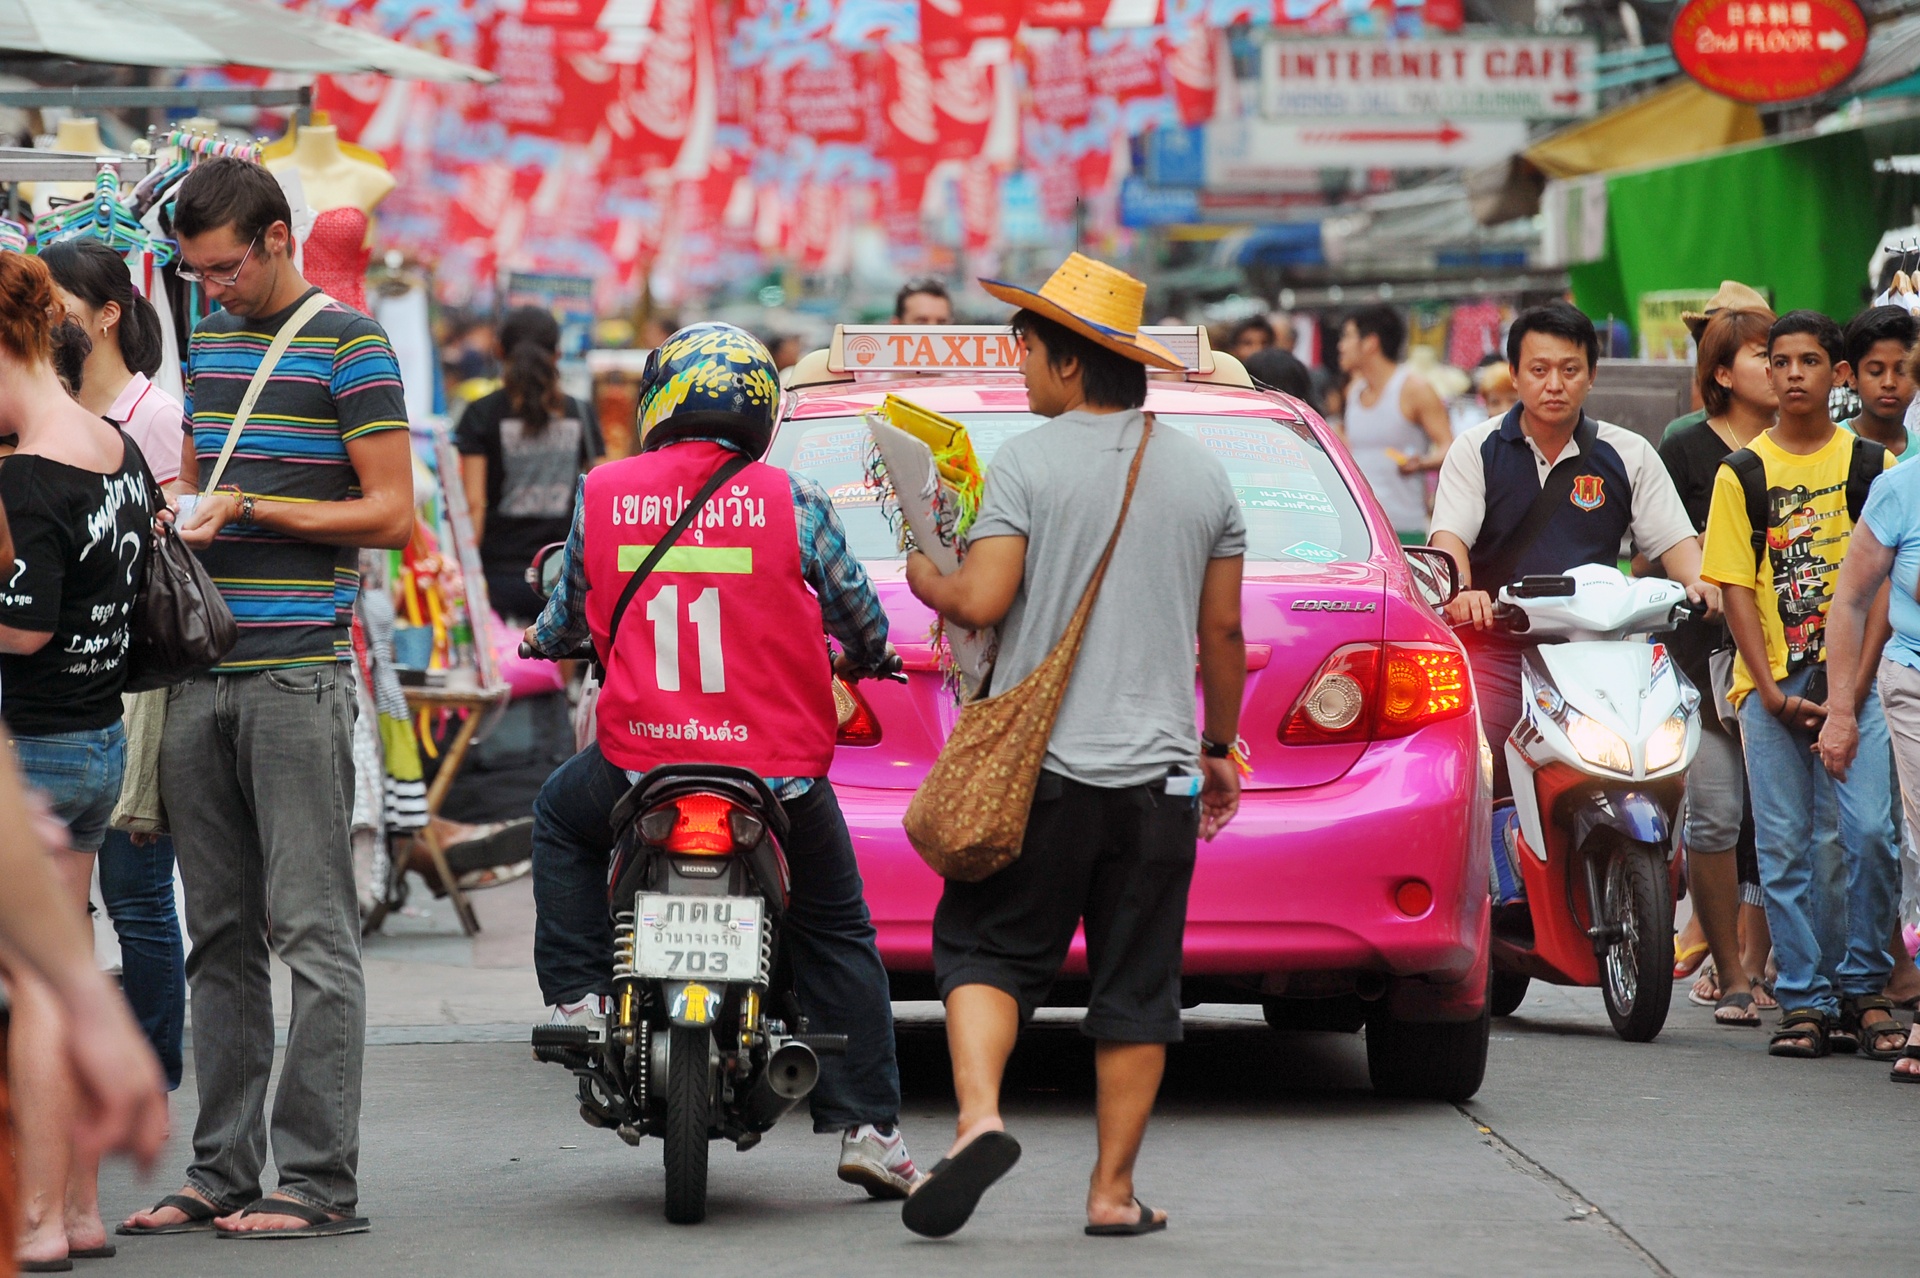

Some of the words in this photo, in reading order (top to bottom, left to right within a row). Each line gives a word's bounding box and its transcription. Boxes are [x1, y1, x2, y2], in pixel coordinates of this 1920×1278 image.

[1695, 25, 1739, 53] 2nd
[1744, 28, 1814, 53] FLOOR
[1279, 50, 1466, 79] INTERNET
[1485, 49, 1579, 79] CAFE
[888, 335, 1028, 367] TAXI-M
[1214, 449, 1232, 457] AXI
[834, 486, 866, 497] FM
[1294, 548, 1334, 558] CNG
[1291, 599, 1376, 614] COROLLA
[646, 584, 726, 693] 11
[681, 865, 718, 874] HONDA
[664, 950, 729, 973] 703
